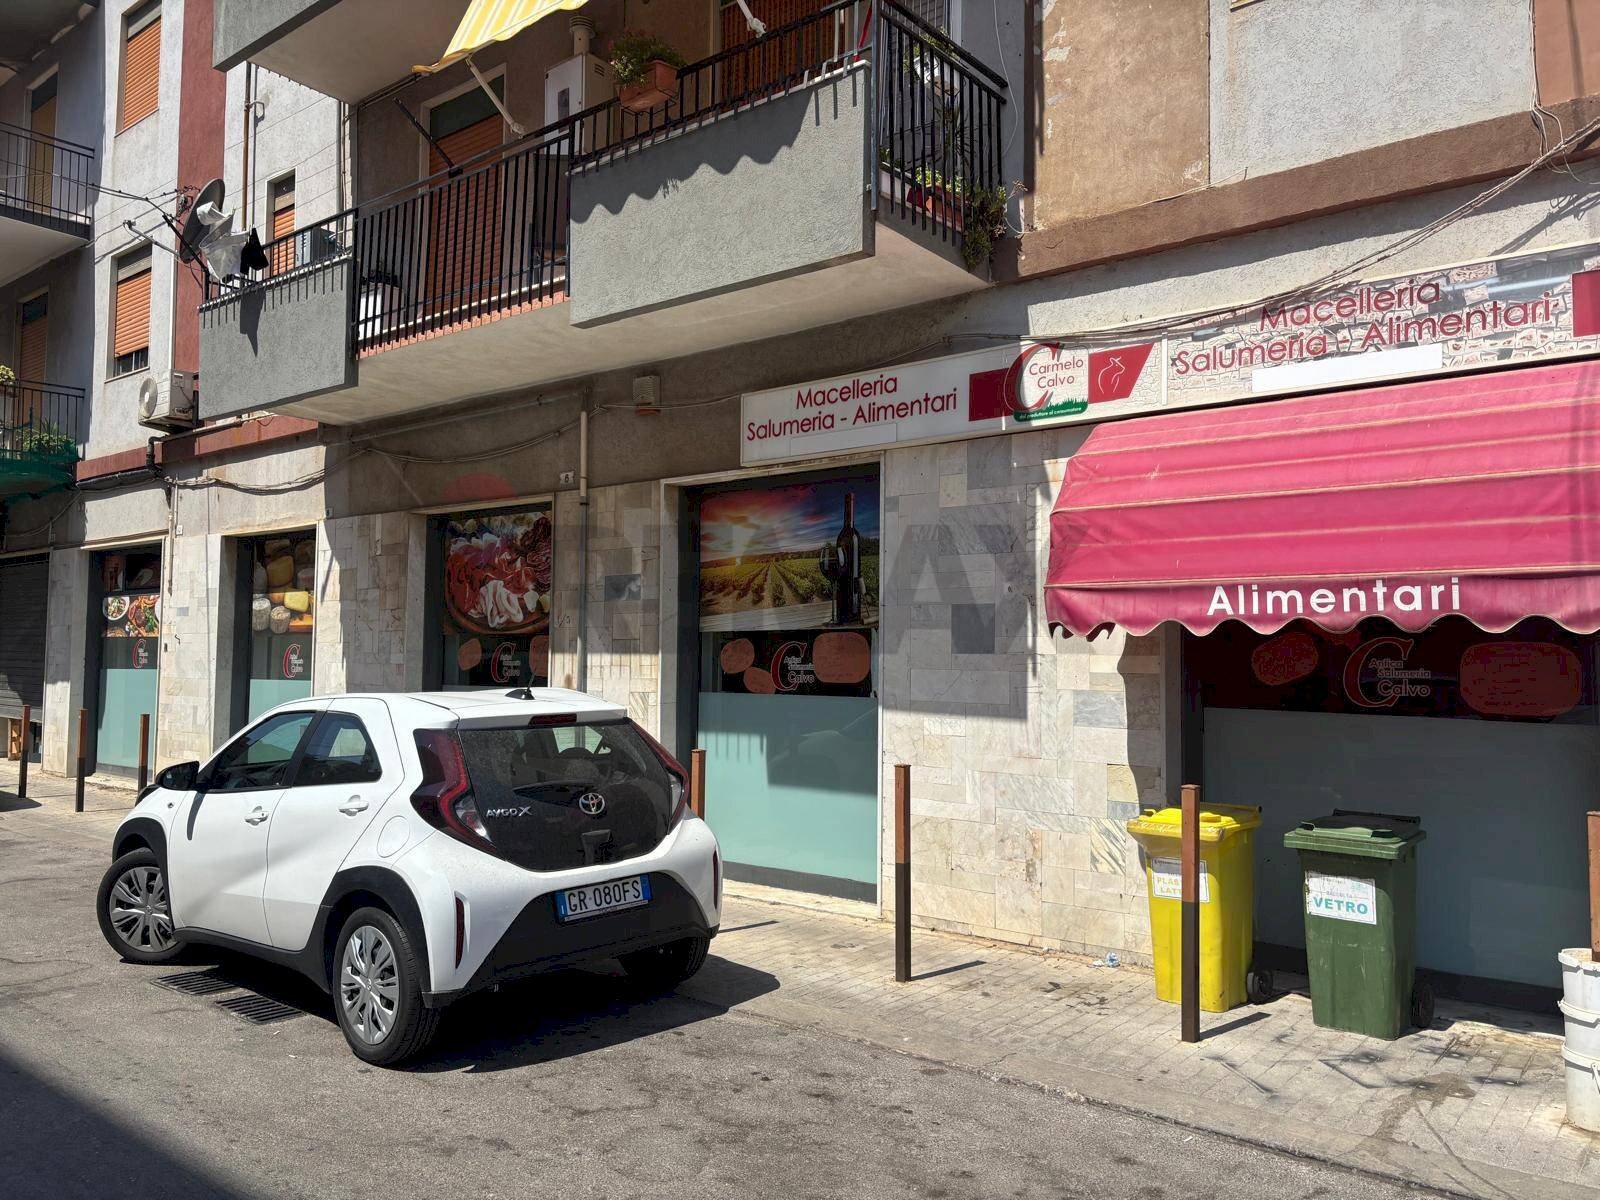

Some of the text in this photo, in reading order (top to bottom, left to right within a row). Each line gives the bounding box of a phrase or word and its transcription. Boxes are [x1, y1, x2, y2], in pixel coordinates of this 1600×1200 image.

[1259, 279, 1441, 332] Macelleria
[1175, 332, 1328, 376] Salumeria
[1361, 291, 1552, 349] Alimentari
[1029, 356, 1084, 376] Carmelo
[1037, 374, 1075, 389] Calvo
[796, 374, 898, 410] Macelleria
[746, 411, 835, 441] Salumeria
[852, 388, 958, 426] Alimentari
[1206, 577, 1460, 616] Alimentari
[1369, 657, 1404, 669] Antica
[788, 671, 816, 684] Calvo
[1377, 667, 1431, 679] Salumeria
[1377, 679, 1431, 697] Calvo
[486, 808, 518, 818] AYGO
[567, 891, 589, 913] GR
[593, 880, 641, 908] 080FS
[1313, 896, 1368, 915] VETRO
